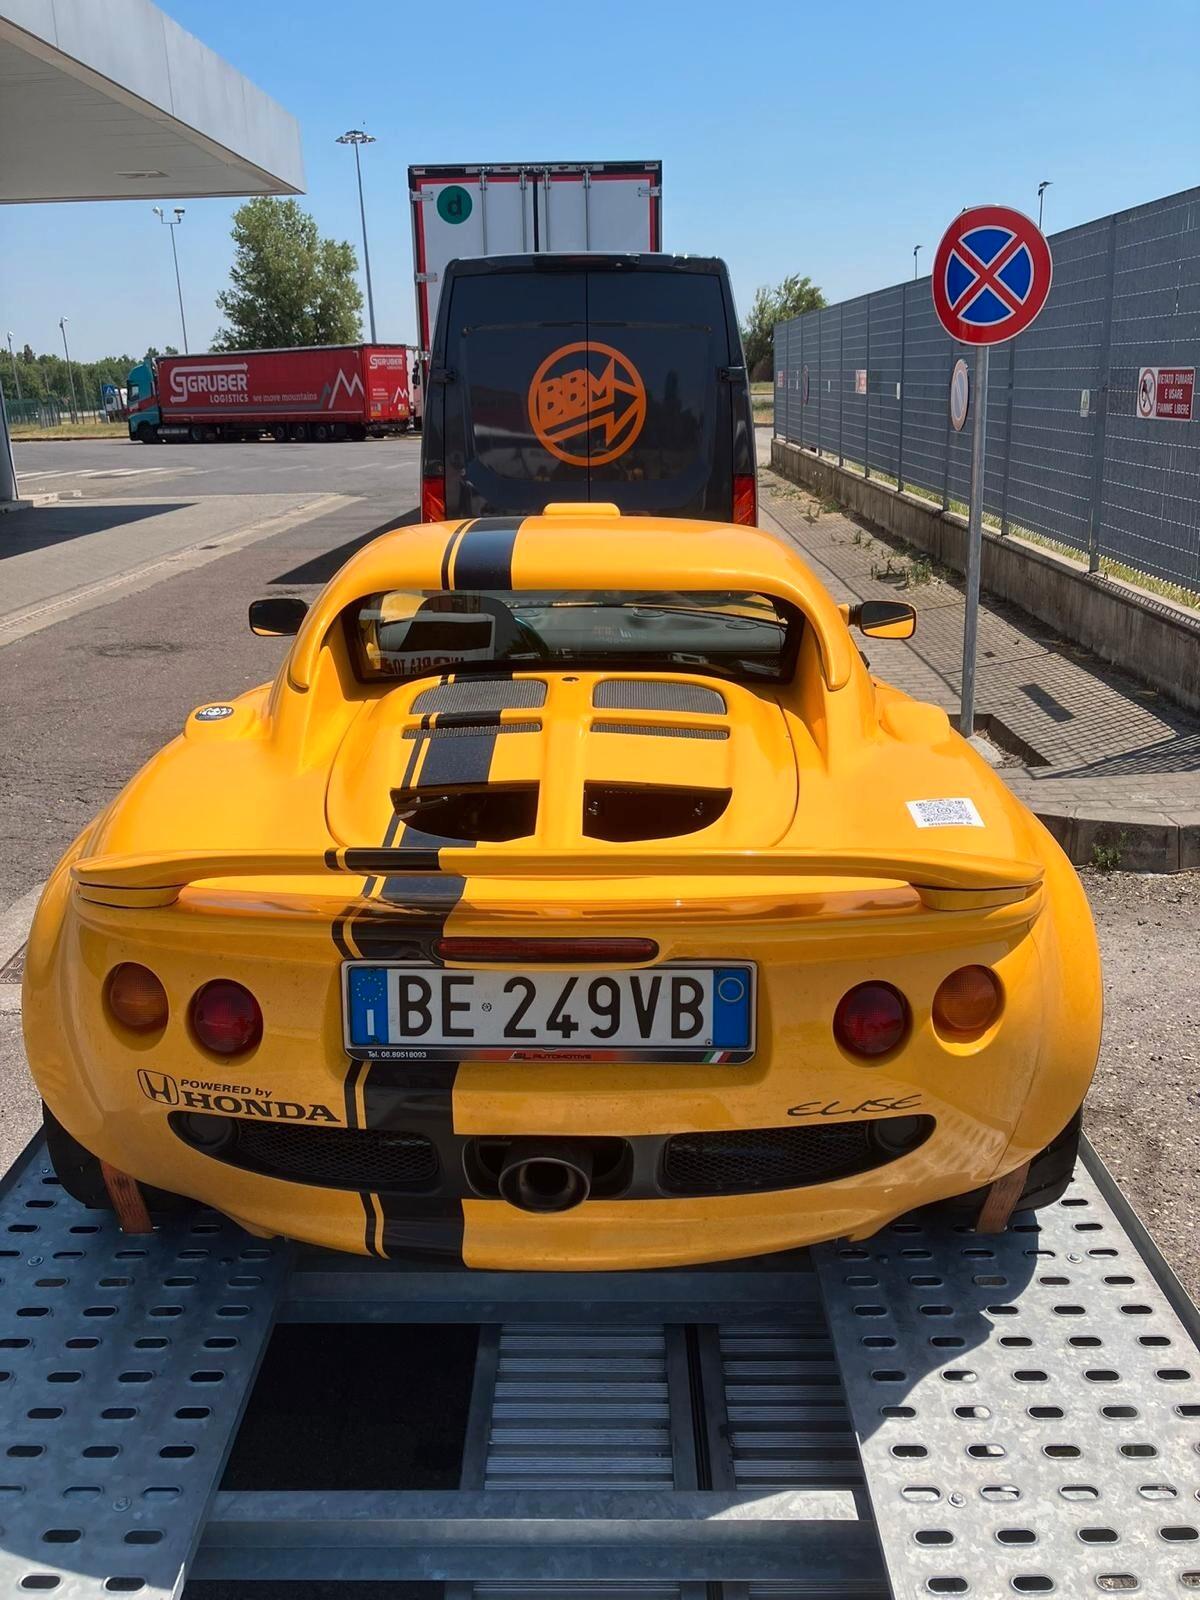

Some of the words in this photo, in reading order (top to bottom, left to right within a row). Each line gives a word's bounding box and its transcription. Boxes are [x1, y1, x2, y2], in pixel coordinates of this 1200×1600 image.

[187, 374, 248, 392] GRUBER
[210, 394, 249, 403] LOGISTICS
[399, 975, 475, 1038] BE
[503, 976, 705, 1039] 249VB
[180, 1079, 252, 1095] POWERED
[255, 1087, 273, 1098] by
[180, 1090, 341, 1123] HONDA
[787, 1094, 922, 1116] ELISE
